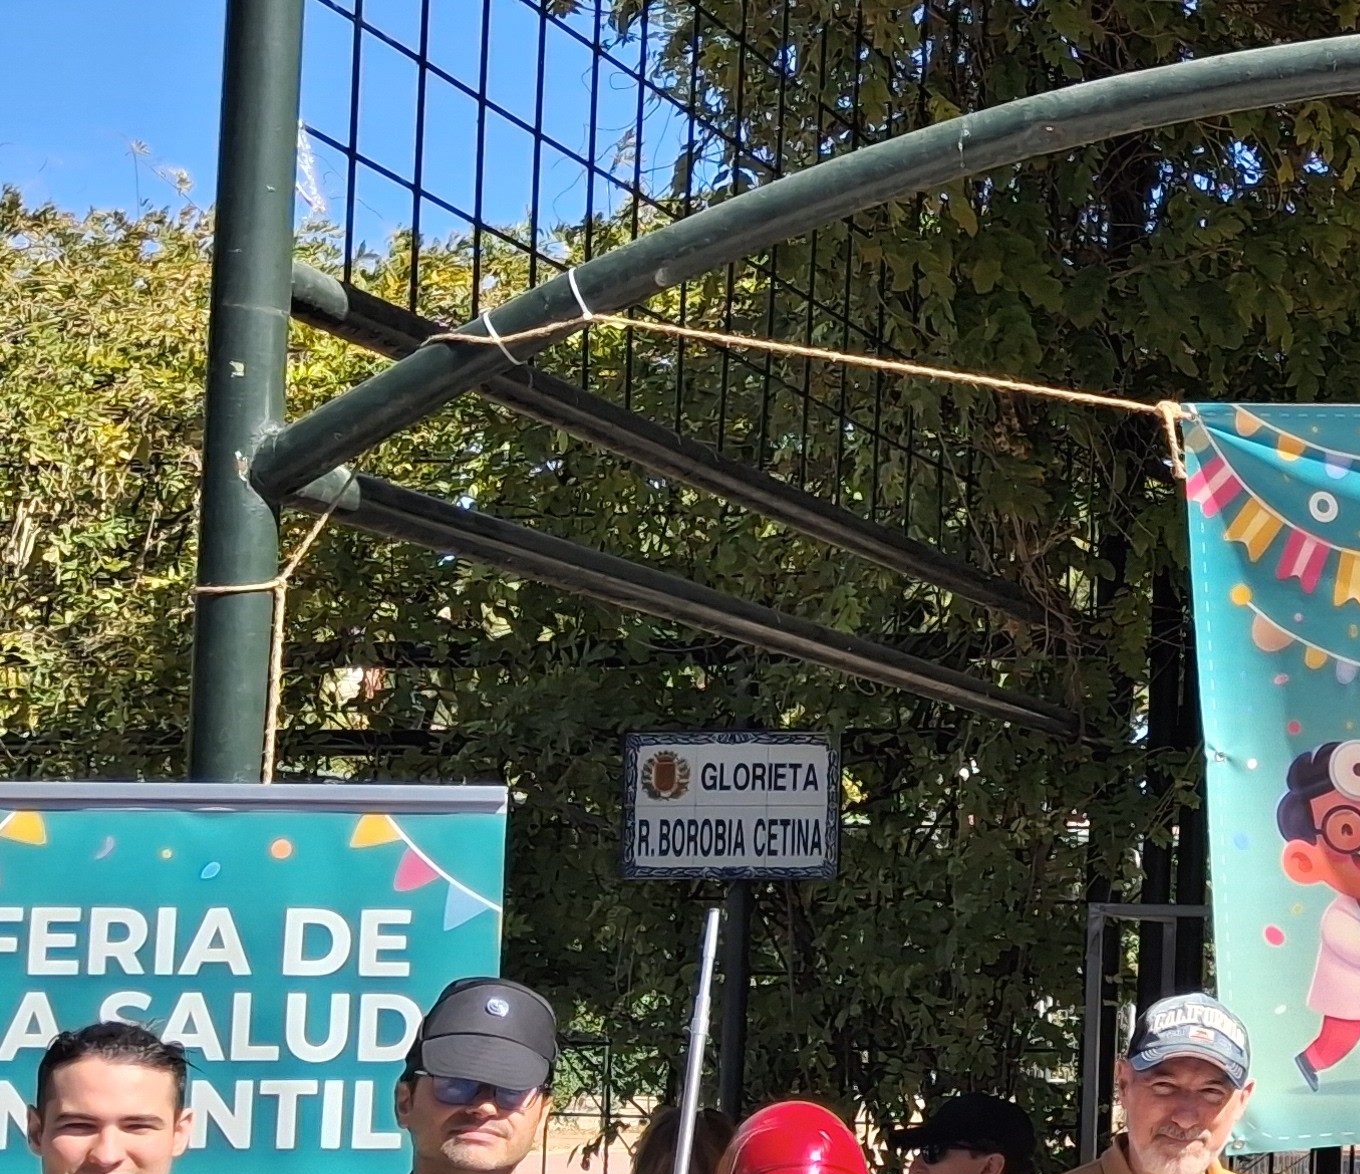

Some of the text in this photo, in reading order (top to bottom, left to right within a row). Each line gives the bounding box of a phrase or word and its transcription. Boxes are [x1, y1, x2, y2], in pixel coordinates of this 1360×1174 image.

[701, 762, 819, 791] GLORIETA
[753, 818, 823, 857] CETINA
[282, 907, 412, 977] DE
